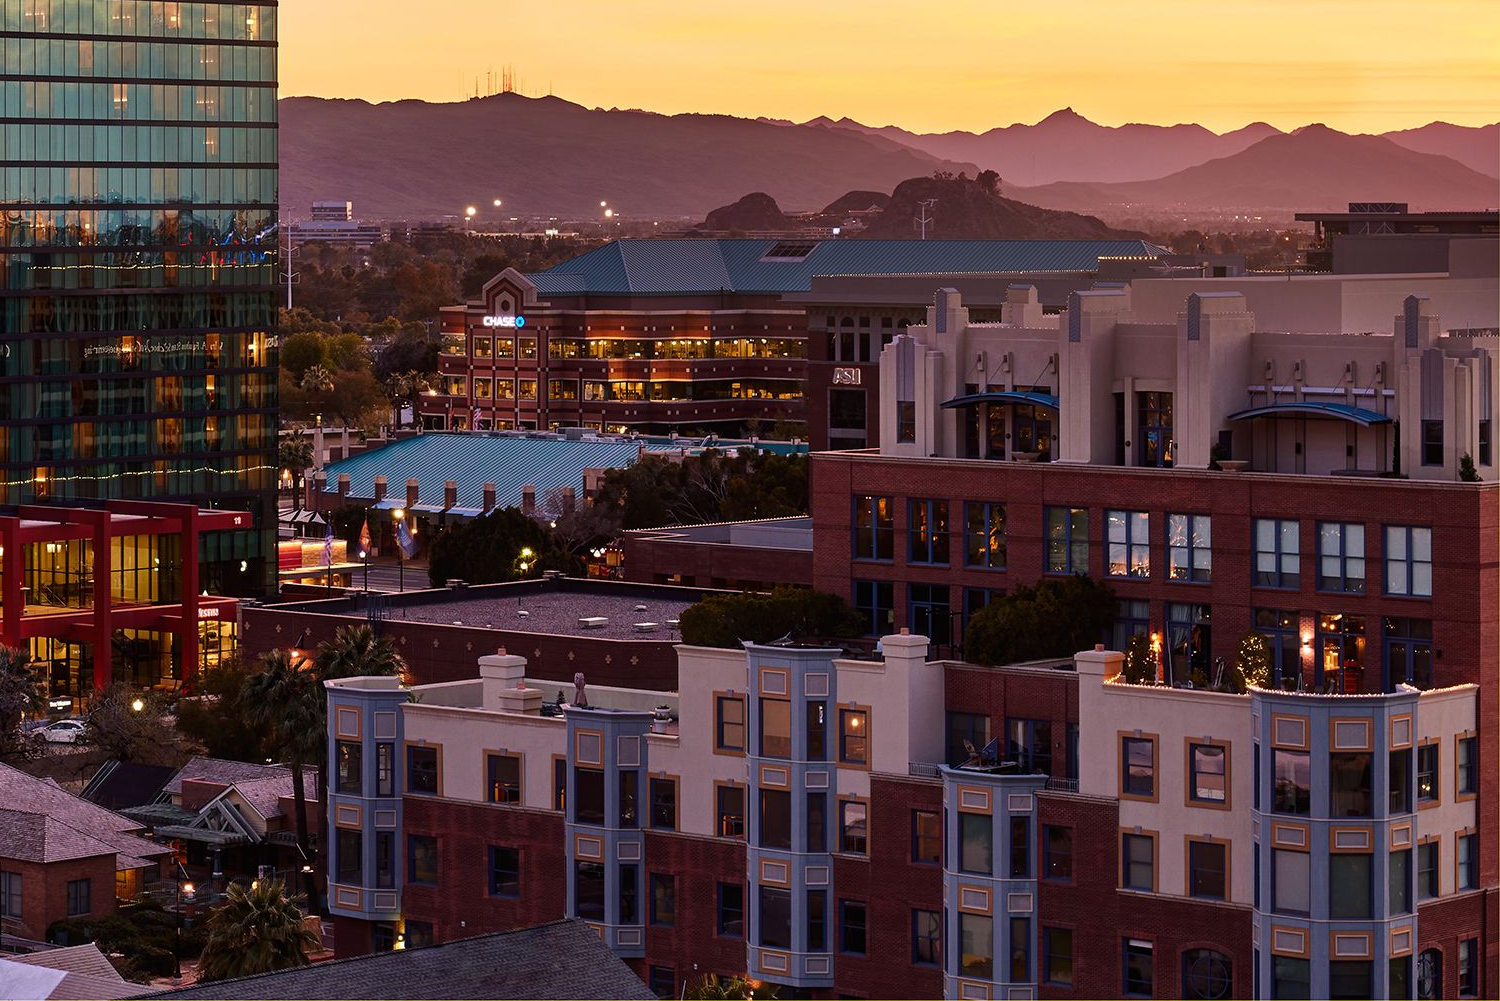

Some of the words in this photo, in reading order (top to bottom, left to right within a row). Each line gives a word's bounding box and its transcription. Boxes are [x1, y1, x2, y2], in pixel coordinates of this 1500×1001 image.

[483, 315, 516, 327] CHASE
[832, 367, 862, 385] ASU
[198, 607, 220, 618] ESTIN
